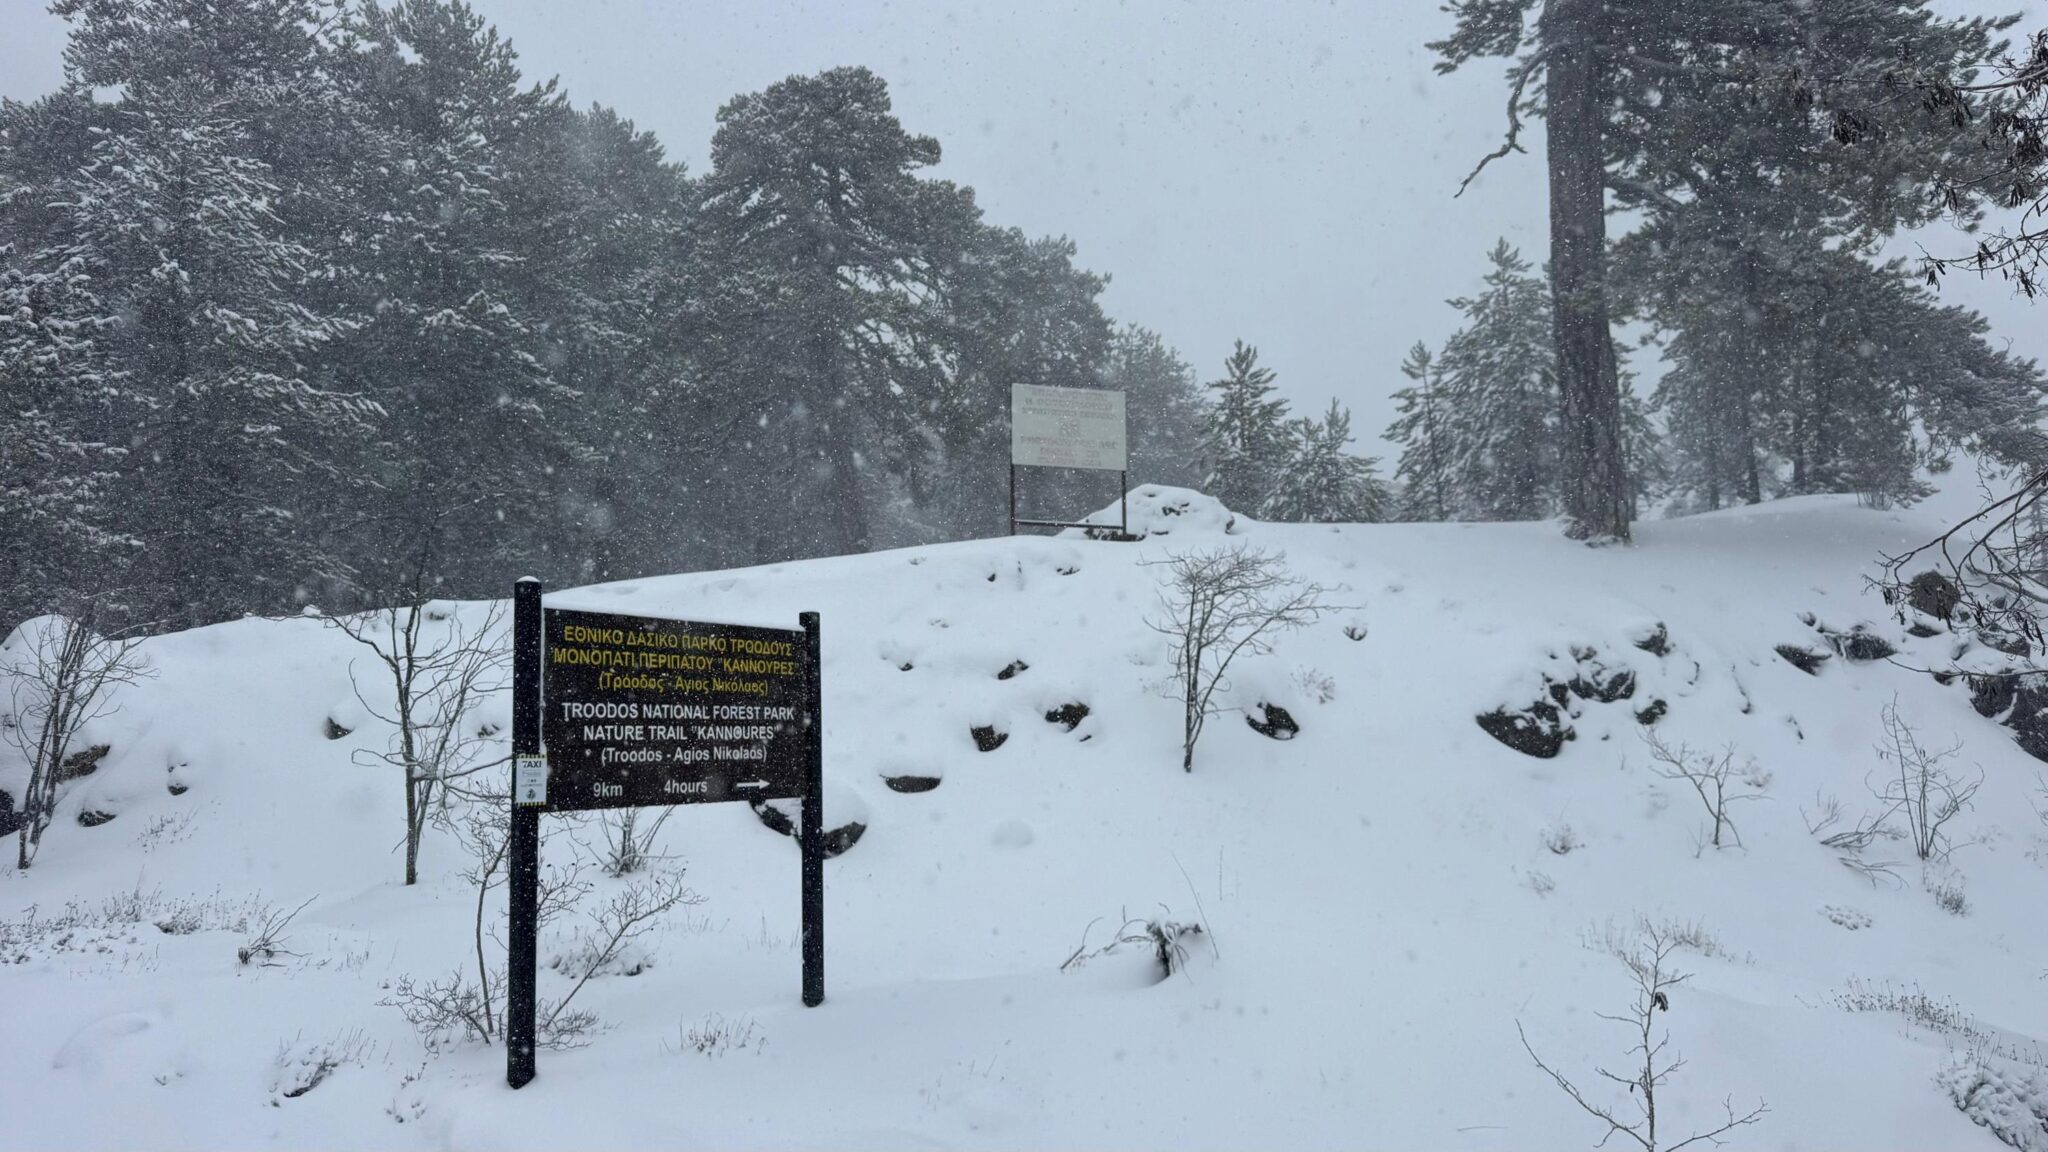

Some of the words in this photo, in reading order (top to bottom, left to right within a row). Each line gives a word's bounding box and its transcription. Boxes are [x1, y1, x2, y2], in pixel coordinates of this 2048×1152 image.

[564, 626, 623, 644] ΕΘΝΙΚΟ
[627, 631, 678, 648] ΔΑΣΙΚΟ
[682, 635, 727, 651] ΠΑΡΚΟ
[730, 639, 792, 656] ΤΡΟΟΔΟΥΣ
[554, 648, 635, 666] ΜΟΝΟΠΑΤΙ
[639, 652, 713, 670] ΠΕΡΙΠΑΤΟΥ
[713, 677, 768, 696] Νικόλαος)
[562, 702, 639, 719] TROODOS
[643, 703, 710, 720] NATIONAL
[713, 705, 761, 720] FOREST
[764, 706, 794, 720] PARK
[584, 725, 644, 741] NATURE
[648, 725, 688, 740] TRAIL
[692, 725, 777, 740] "KANNOURES"
[601, 747, 663, 767] (Troodos
[673, 746, 710, 764] Agios
[713, 745, 768, 763] Nikolaos)
[593, 781, 623, 797] 9km
[664, 779, 708, 794] 4hours
